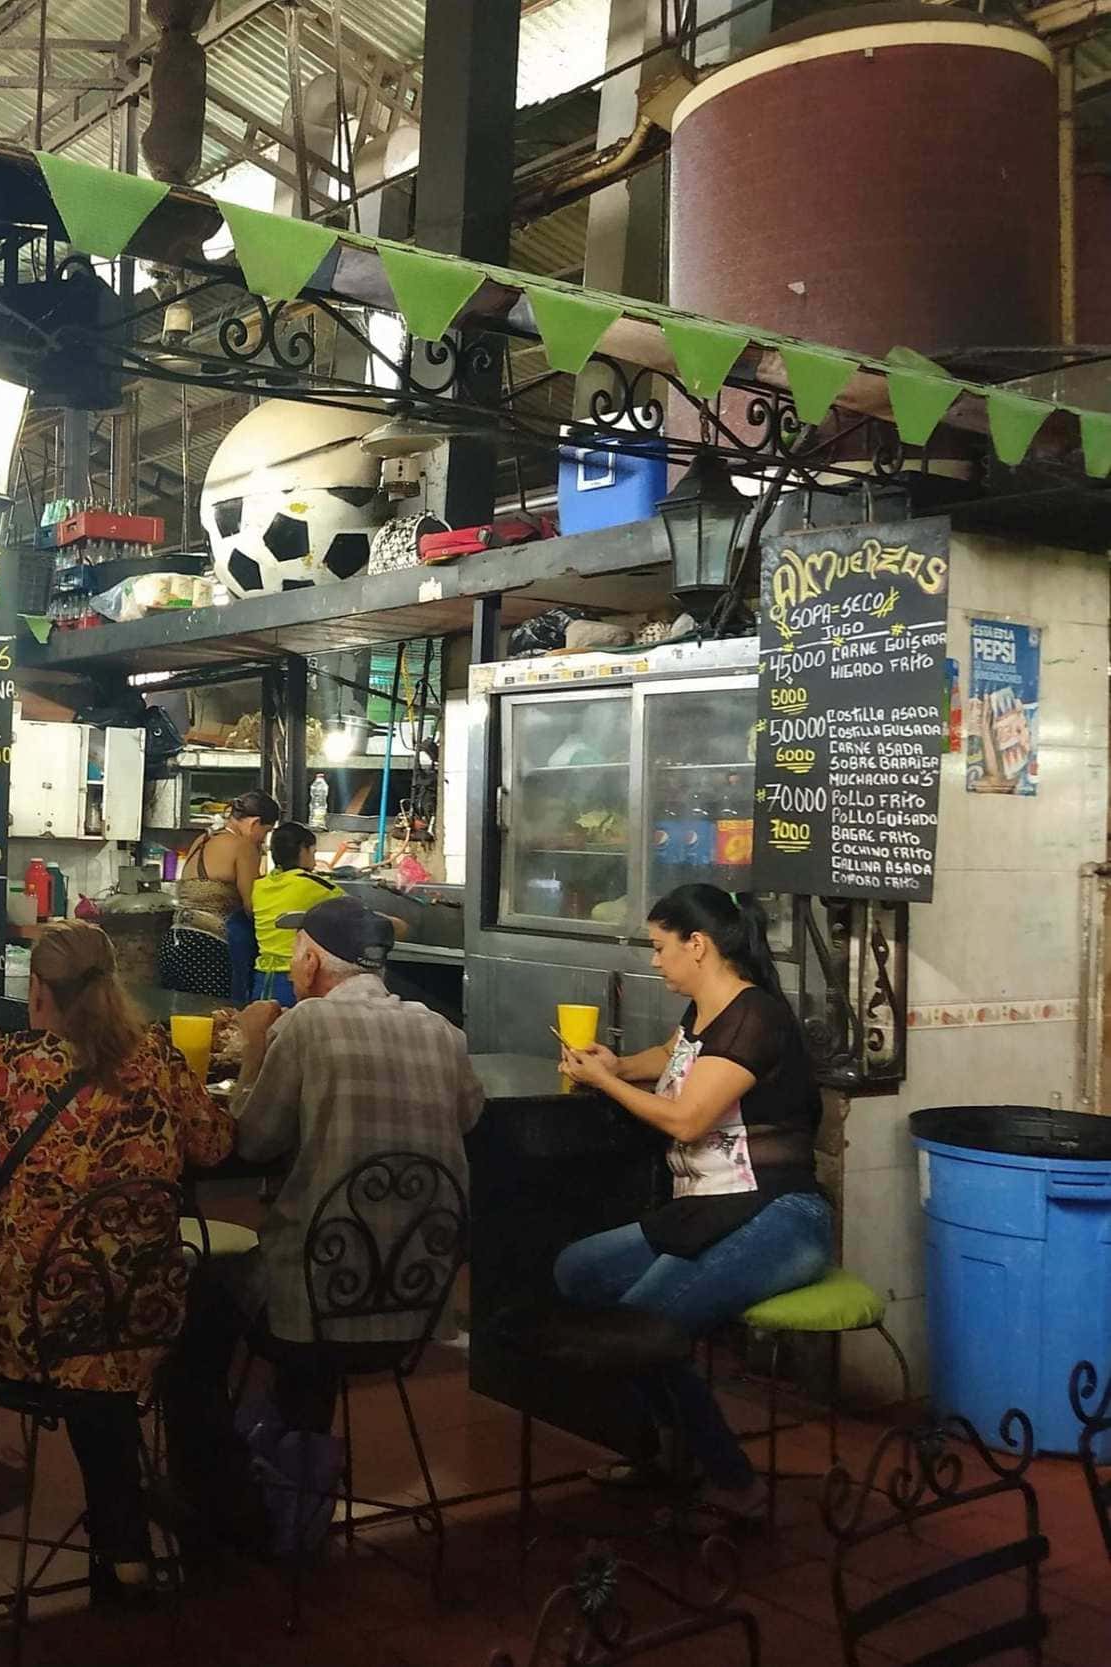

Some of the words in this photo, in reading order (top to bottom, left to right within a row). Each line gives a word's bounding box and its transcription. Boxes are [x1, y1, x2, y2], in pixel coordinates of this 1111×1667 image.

[770, 539, 948, 622] ALMUERZOS
[821, 622, 864, 640] JUGO
[832, 641, 879, 662] CARNE
[885, 632, 948, 653] GUISADA
[973, 638, 1016, 664] PEPSI
[831, 664, 884, 680] HIGADO
[890, 652, 934, 673] FRITO
[771, 687, 807, 706] 5000
[827, 706, 885, 723] COSTILLA
[891, 706, 939, 722] ASADA
[828, 724, 881, 739] COSTILLA
[882, 723, 942, 737] GUISADA
[776, 747, 816, 762] 6000
[829, 740, 871, 754] CARNE
[877, 742, 924, 756] ASADA
[829, 756, 878, 770] SOBRE
[879, 755, 939, 770] BARRIGA
[828, 772, 899, 786] MUCHACHO
[901, 774, 920, 786] EN
[832, 789, 874, 807] POLLO
[880, 790, 926, 808] FRITO
[832, 808, 875, 824] POLLO
[876, 810, 938, 827] GUISADO
[770, 818, 811, 840] 7000
[832, 825, 876, 842] BAGRE
[880, 831, 921, 846] FRITO
[832, 843, 890, 858] COCHINO
[893, 846, 933, 861] FRITO
[832, 857, 882, 873] GALLINA
[885, 861, 933, 876] ASADA
[885, 876, 921, 889] FRITO
